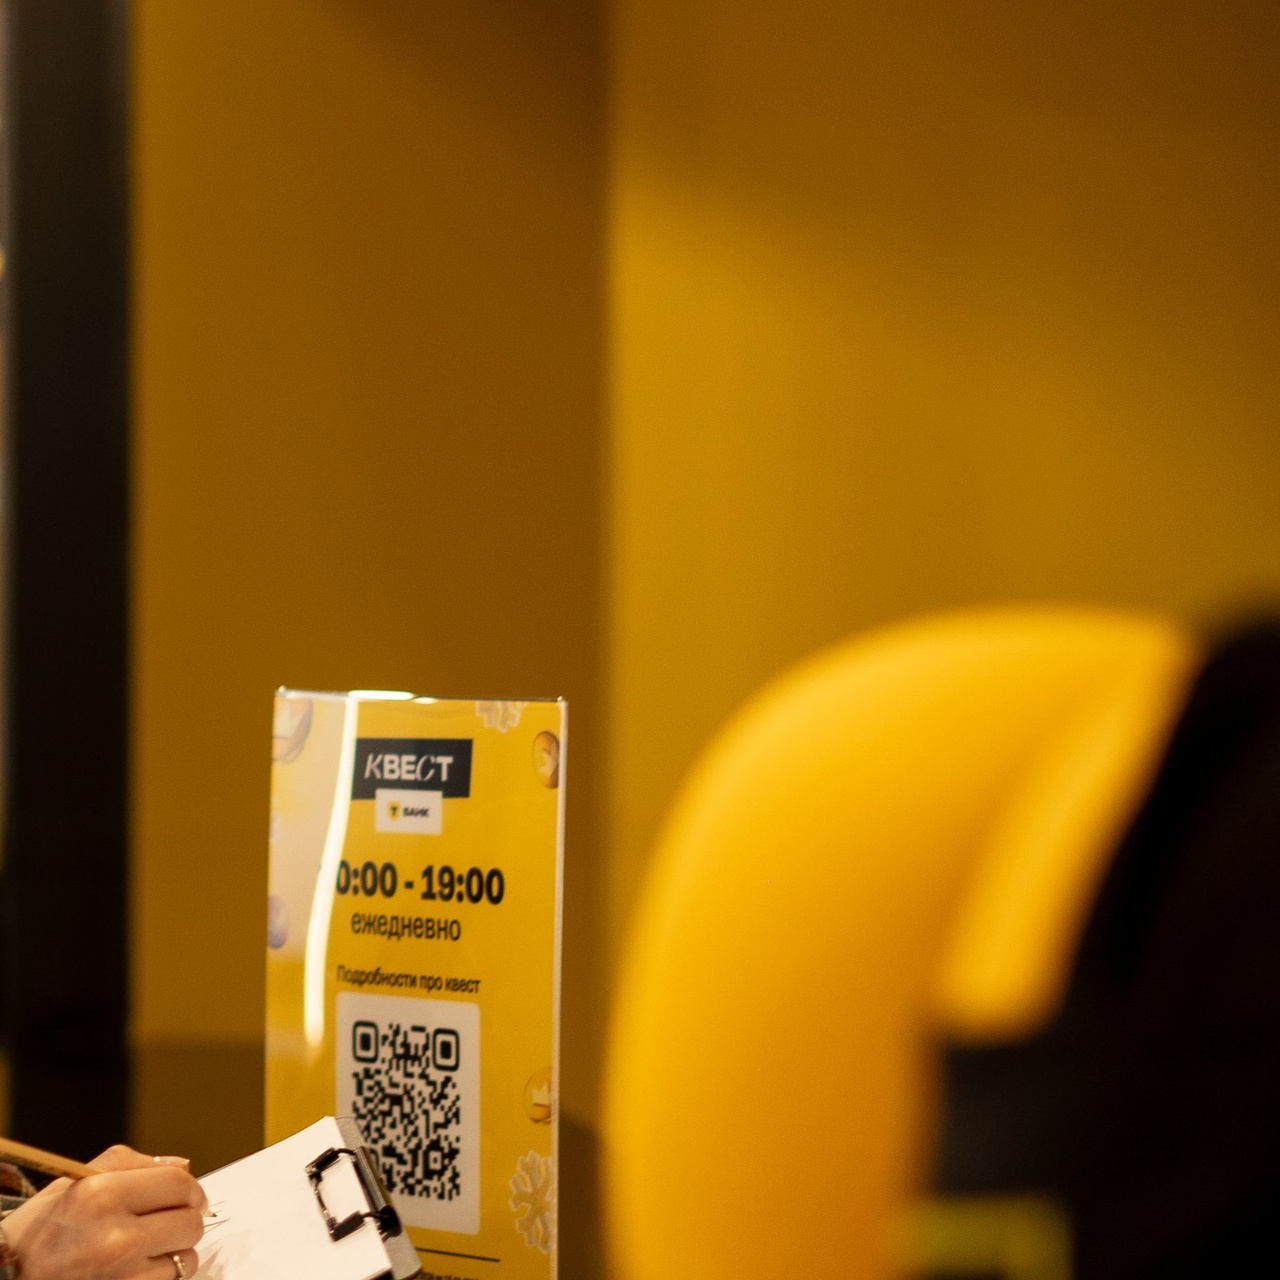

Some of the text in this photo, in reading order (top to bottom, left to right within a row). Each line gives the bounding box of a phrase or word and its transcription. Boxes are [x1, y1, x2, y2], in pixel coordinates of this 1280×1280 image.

[364, 753, 454, 782] КВЕСТ
[336, 859, 398, 898] 0:00
[421, 865, 505, 905] 19:00
[351, 912, 461, 941] ежедневно
[337, 965, 482, 994] Подробности про квест
